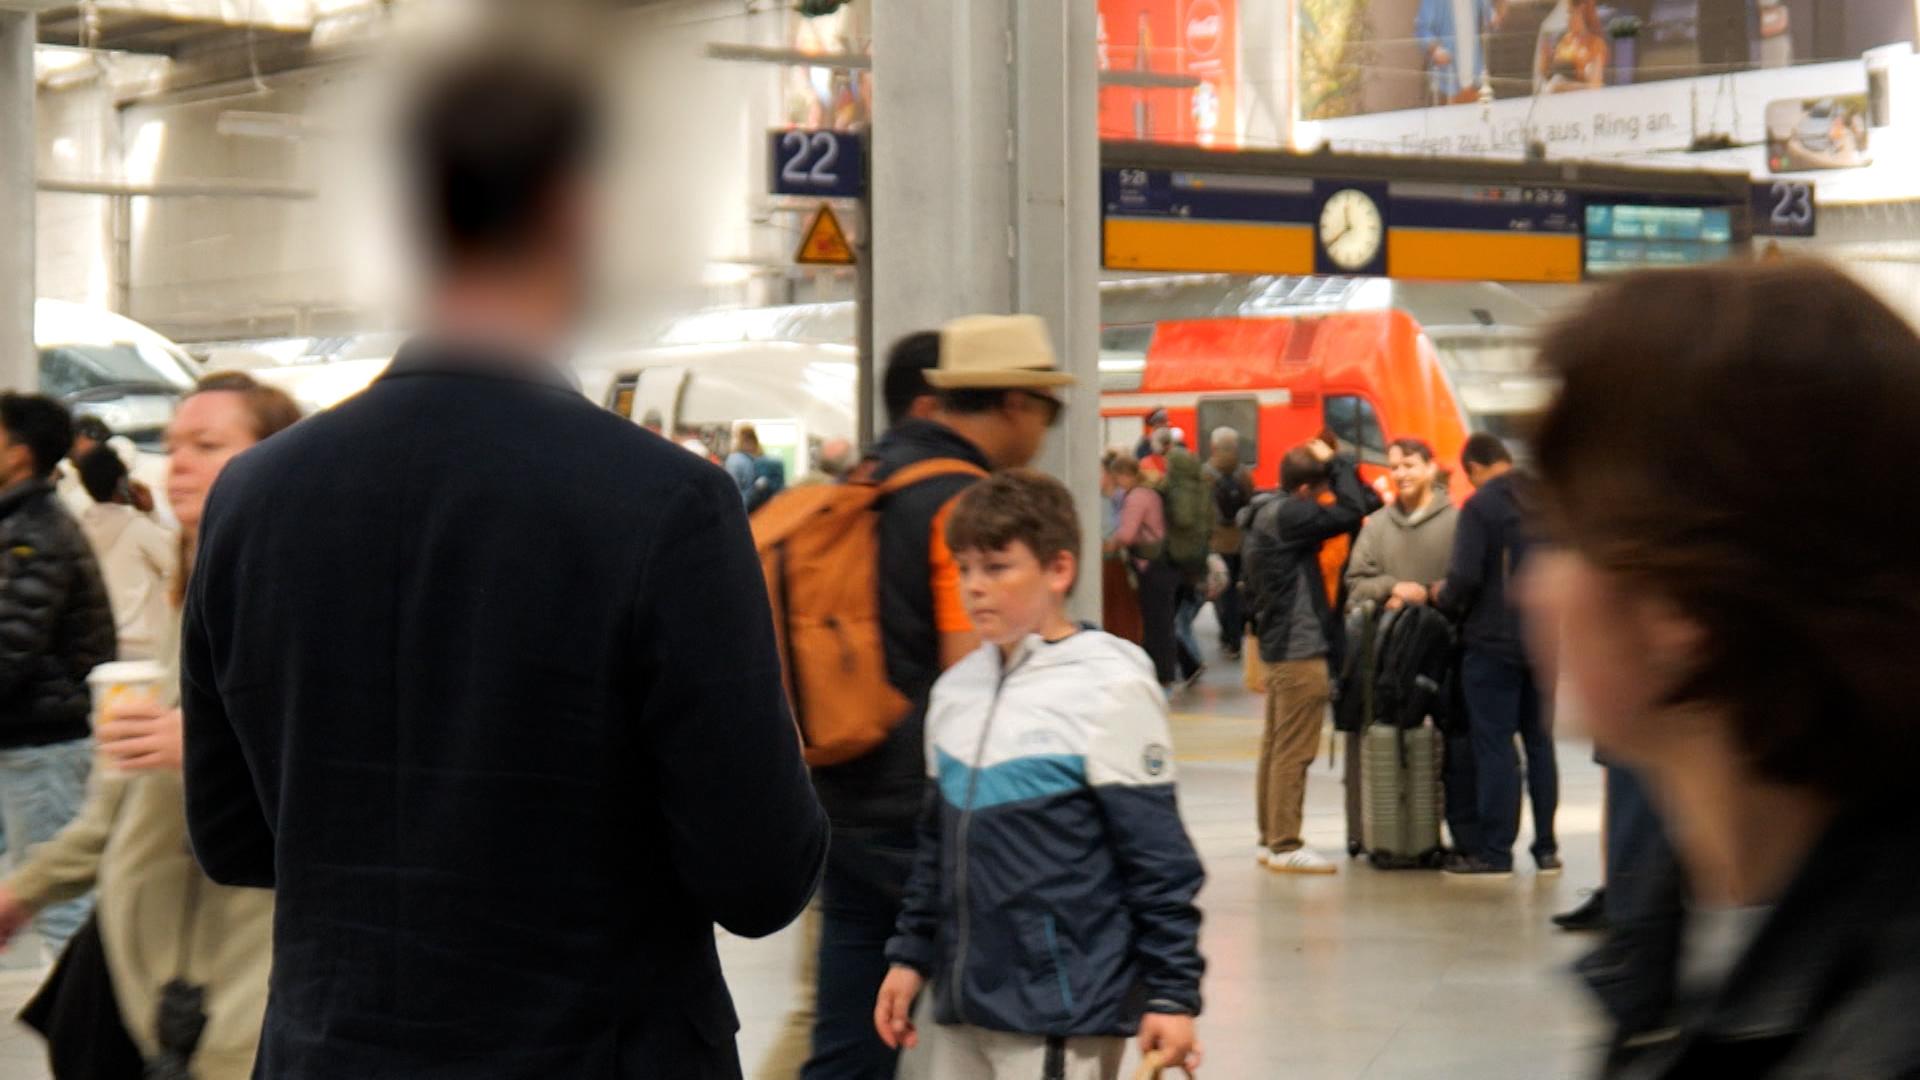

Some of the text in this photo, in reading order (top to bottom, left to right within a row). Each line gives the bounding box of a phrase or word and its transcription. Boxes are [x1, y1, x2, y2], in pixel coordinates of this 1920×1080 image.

[1548, 121, 1586, 143] aus,
[1592, 111, 1640, 141] Ring
[1646, 111, 1678, 131] an.
[781, 129, 838, 182] 22
[1770, 181, 1813, 224] 23
